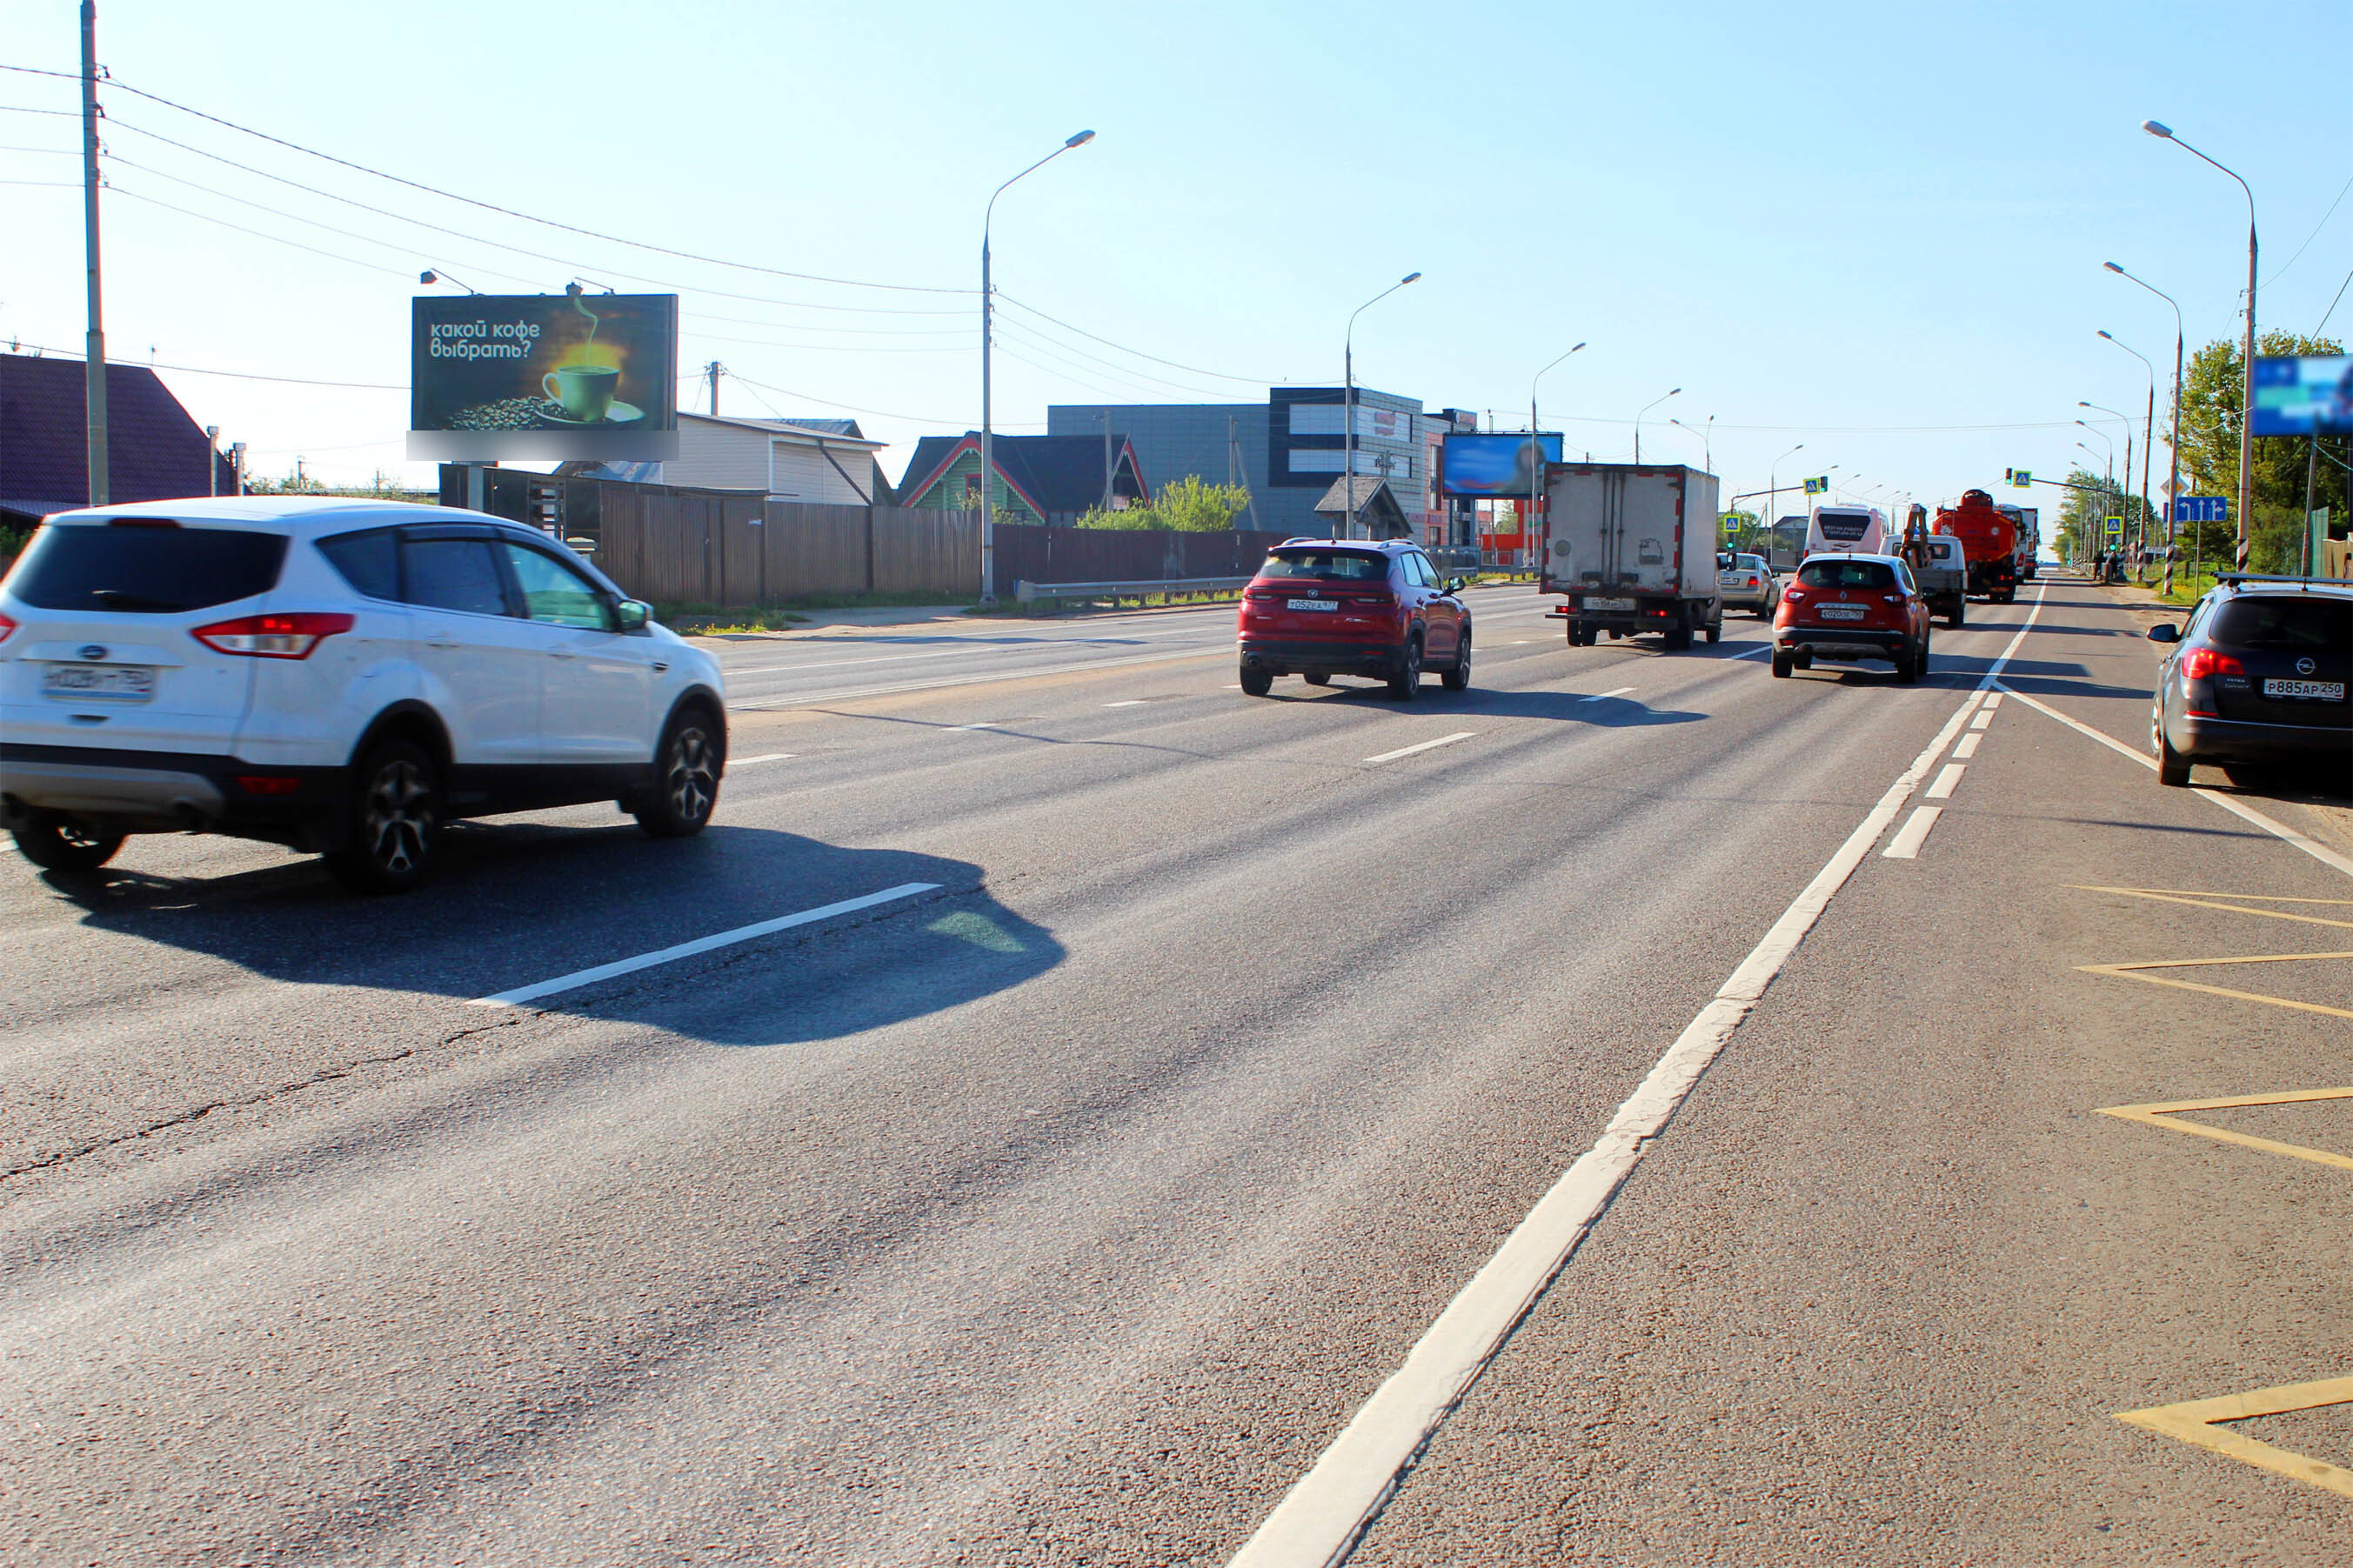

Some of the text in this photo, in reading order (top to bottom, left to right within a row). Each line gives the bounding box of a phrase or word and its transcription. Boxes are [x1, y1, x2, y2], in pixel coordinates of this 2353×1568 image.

[431, 319, 540, 342] какой кофе
[430, 337, 531, 362] выбрать?
